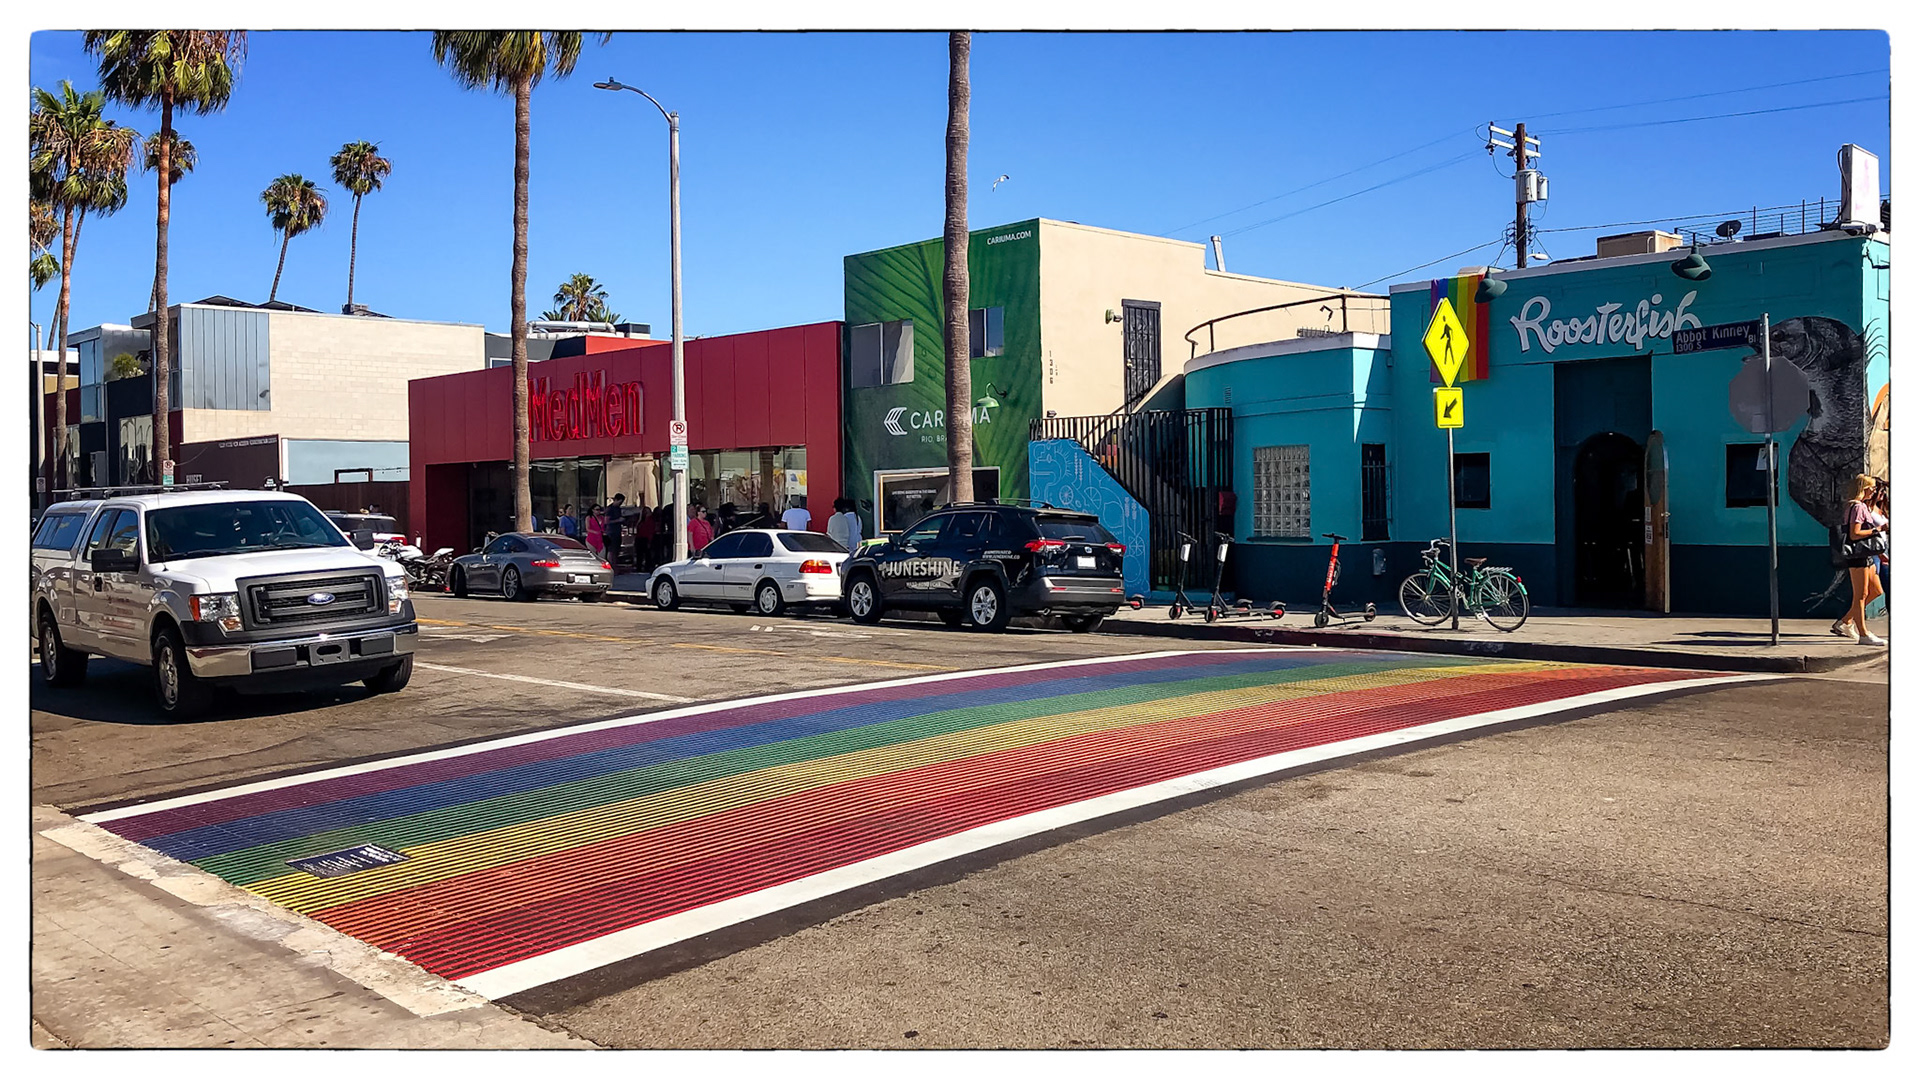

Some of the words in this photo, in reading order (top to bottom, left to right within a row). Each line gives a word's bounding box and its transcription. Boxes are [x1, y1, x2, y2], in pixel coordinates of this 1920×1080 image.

[987, 230, 1031, 245] CARIUMA.COM
[1510, 290, 1702, 353] Roosterfish
[1676, 329, 1707, 344] Abbot
[1712, 325, 1750, 340] Kinney
[1676, 343, 1694, 352] 1300
[1696, 341, 1702, 350] S
[528, 369, 644, 442] MedMen
[910, 406, 991, 429] CARMA
[888, 560, 960, 577] JUNESHINE
